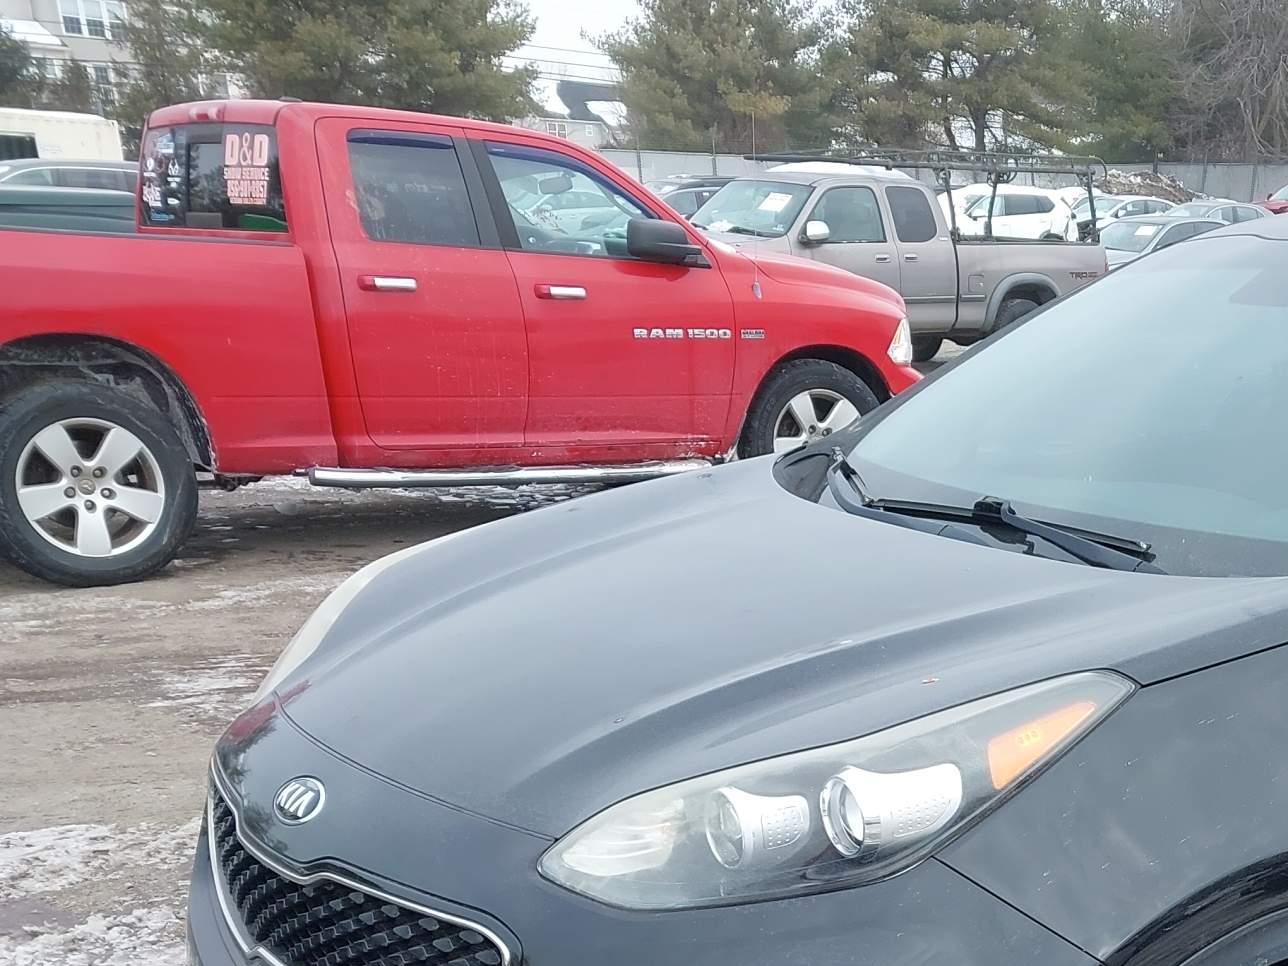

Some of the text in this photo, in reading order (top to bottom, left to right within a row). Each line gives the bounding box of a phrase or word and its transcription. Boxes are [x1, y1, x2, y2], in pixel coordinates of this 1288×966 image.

[224, 132, 269, 166] D&D
[633, 328, 684, 338] RAM
[687, 328, 732, 338] 1500
